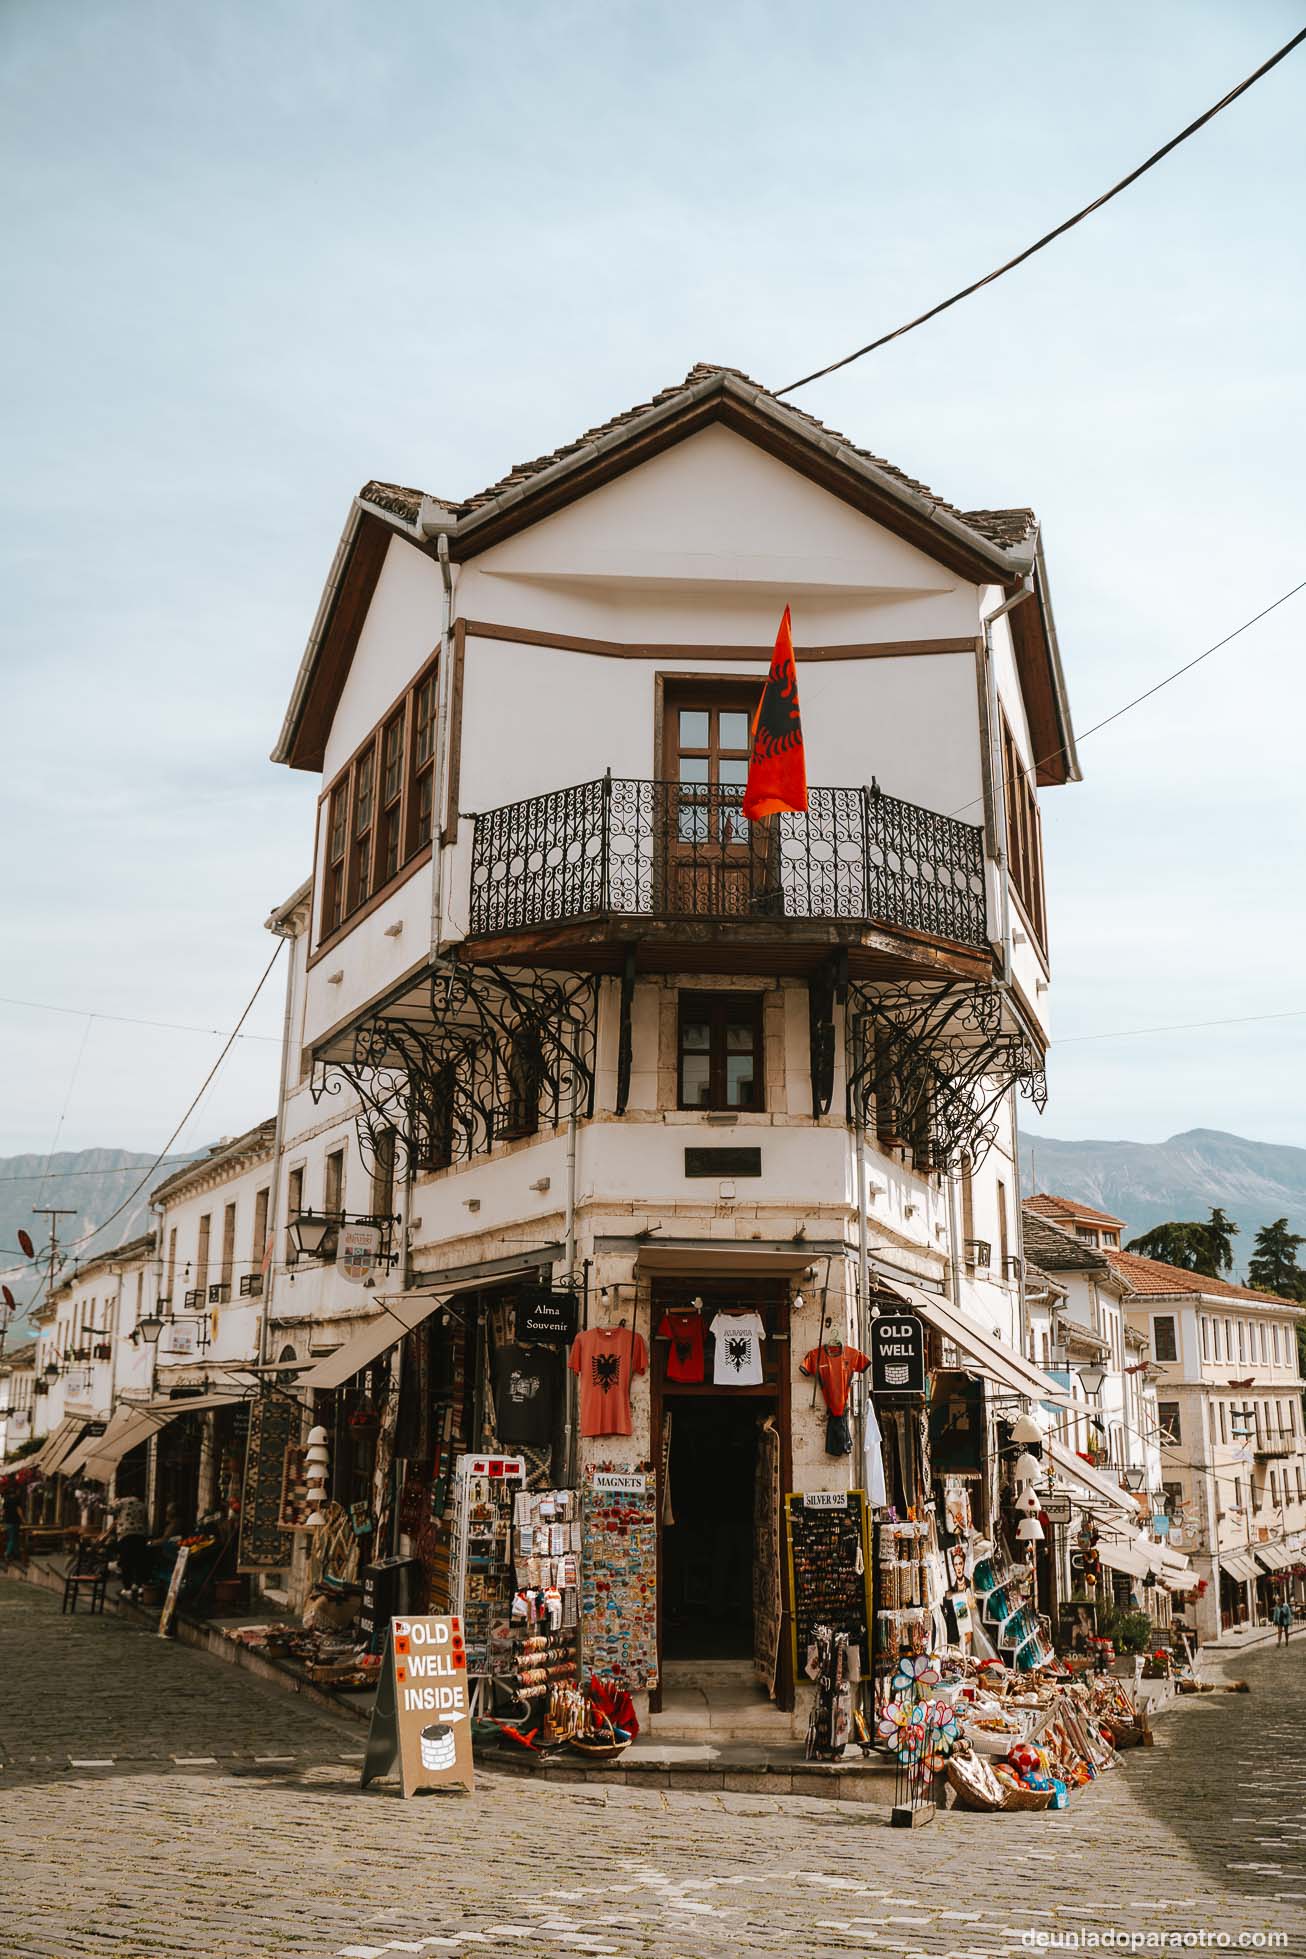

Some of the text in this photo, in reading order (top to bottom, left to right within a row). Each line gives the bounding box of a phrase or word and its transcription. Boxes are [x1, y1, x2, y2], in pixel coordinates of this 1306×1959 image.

[534, 1304, 560, 1315] Alma
[526, 1319, 568, 1331] Souvenir
[723, 1329, 753, 1337] ALBANIA
[880, 1325, 913, 1338] OLD
[879, 1344, 915, 1356] WELL
[597, 1477, 642, 1487] MAGNETS
[806, 1494, 845, 1505] SILVER 925
[411, 1623, 449, 1645] OLD
[408, 1655, 457, 1678] WELL
[404, 1686, 465, 1711] INSIDE
